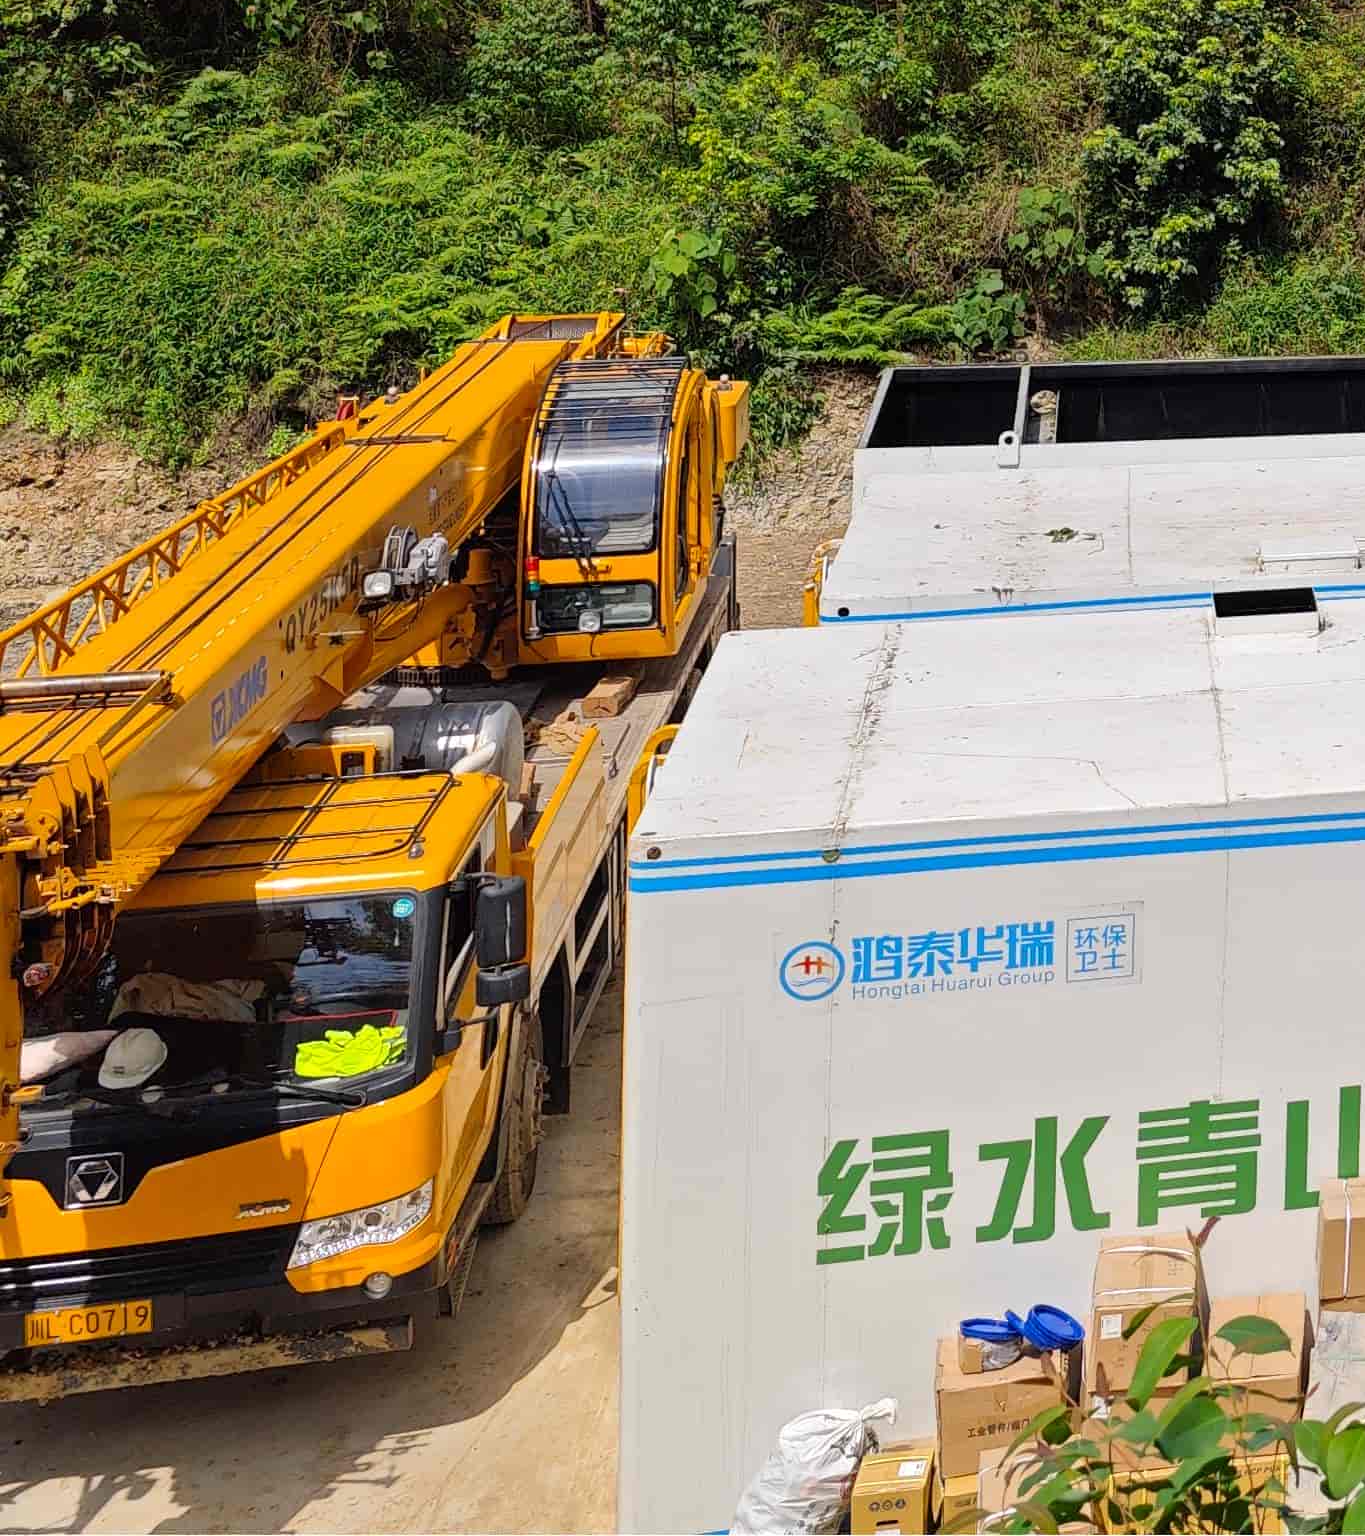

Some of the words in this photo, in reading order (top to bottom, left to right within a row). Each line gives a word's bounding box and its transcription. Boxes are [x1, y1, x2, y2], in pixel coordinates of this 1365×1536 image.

[1073, 923, 1127, 949] 环保
[851, 920, 1055, 984] 鸿泰华瑞
[1073, 948, 1127, 974] 卫士
[852, 983, 926, 1001] Hongtai
[931, 976, 992, 993] Huarui
[998, 970, 1055, 987] Group
